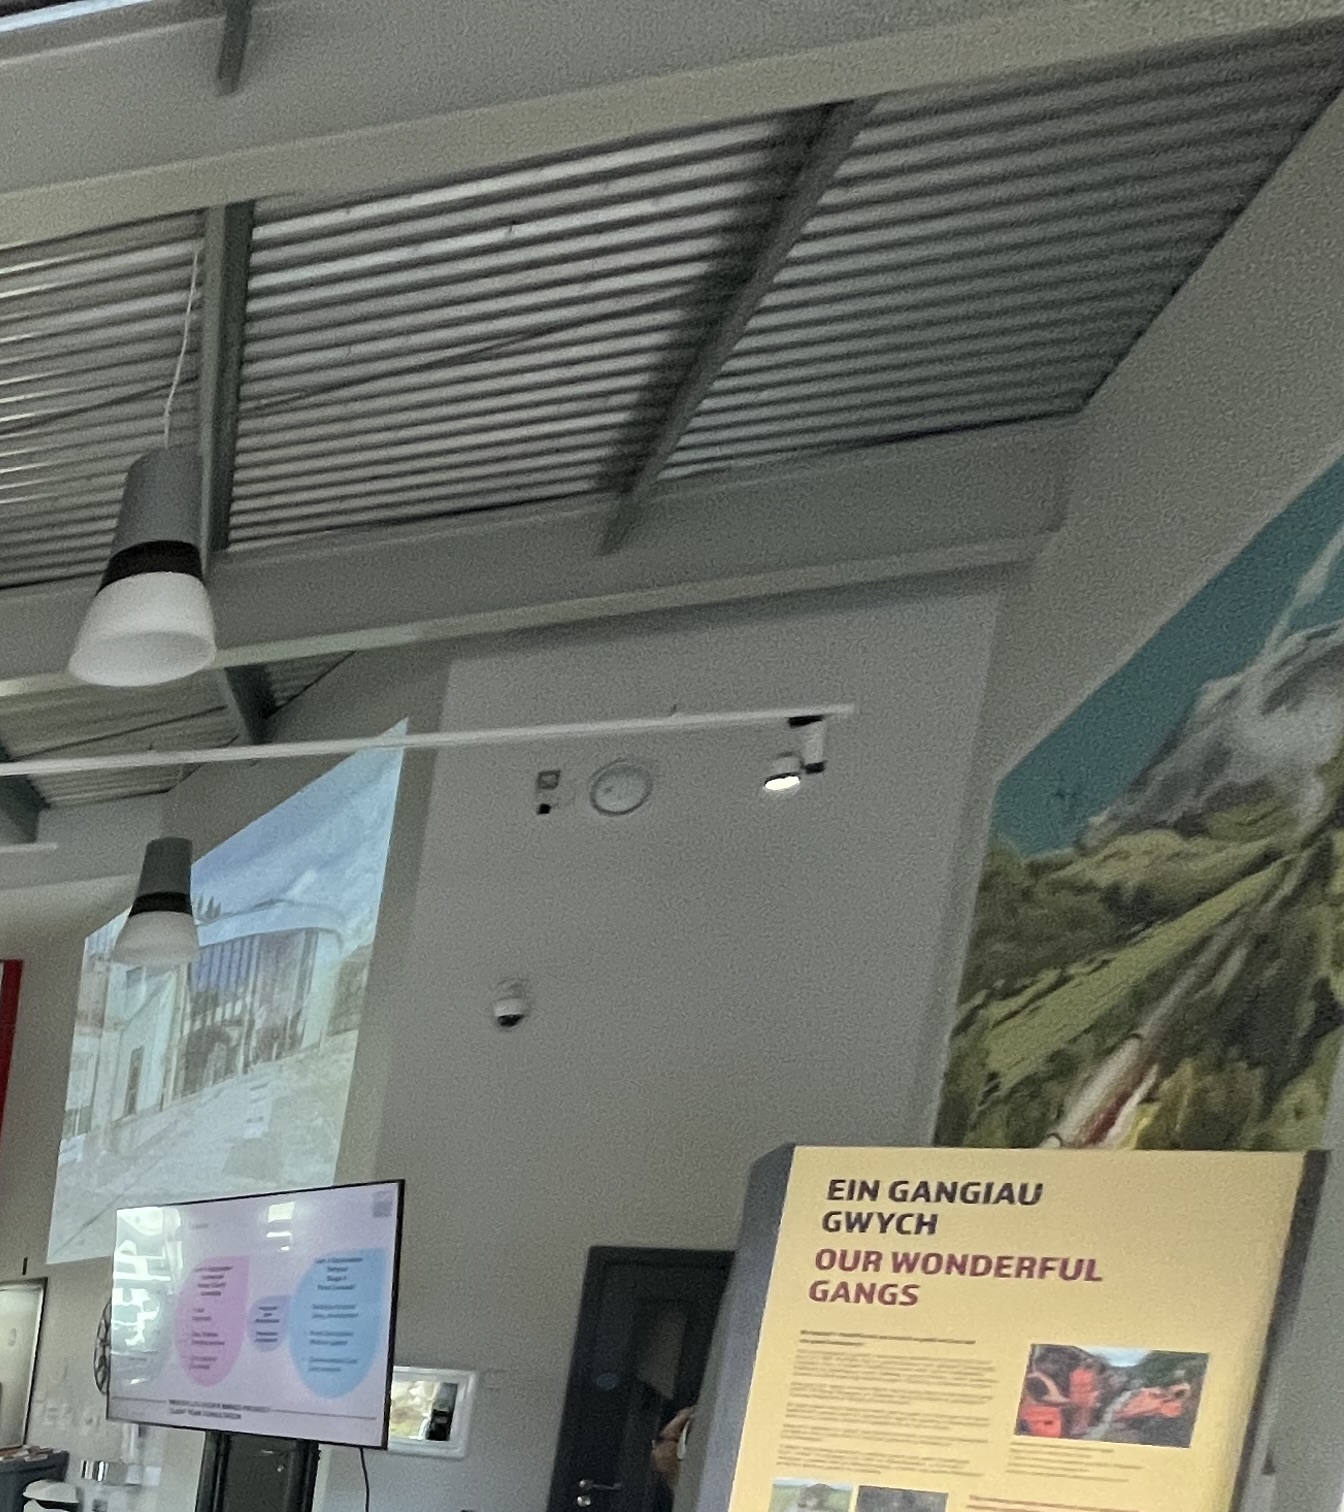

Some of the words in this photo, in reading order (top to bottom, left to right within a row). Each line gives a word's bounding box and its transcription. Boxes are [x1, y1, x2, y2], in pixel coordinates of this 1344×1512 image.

[826, 1178, 881, 1203] EIN
[887, 1179, 1044, 1206] GANGIAU
[821, 1210, 939, 1236] GWYCH
[814, 1248, 884, 1273] OUR
[891, 1250, 1103, 1282] WONDERFUL
[808, 1279, 921, 1307] GANGS
